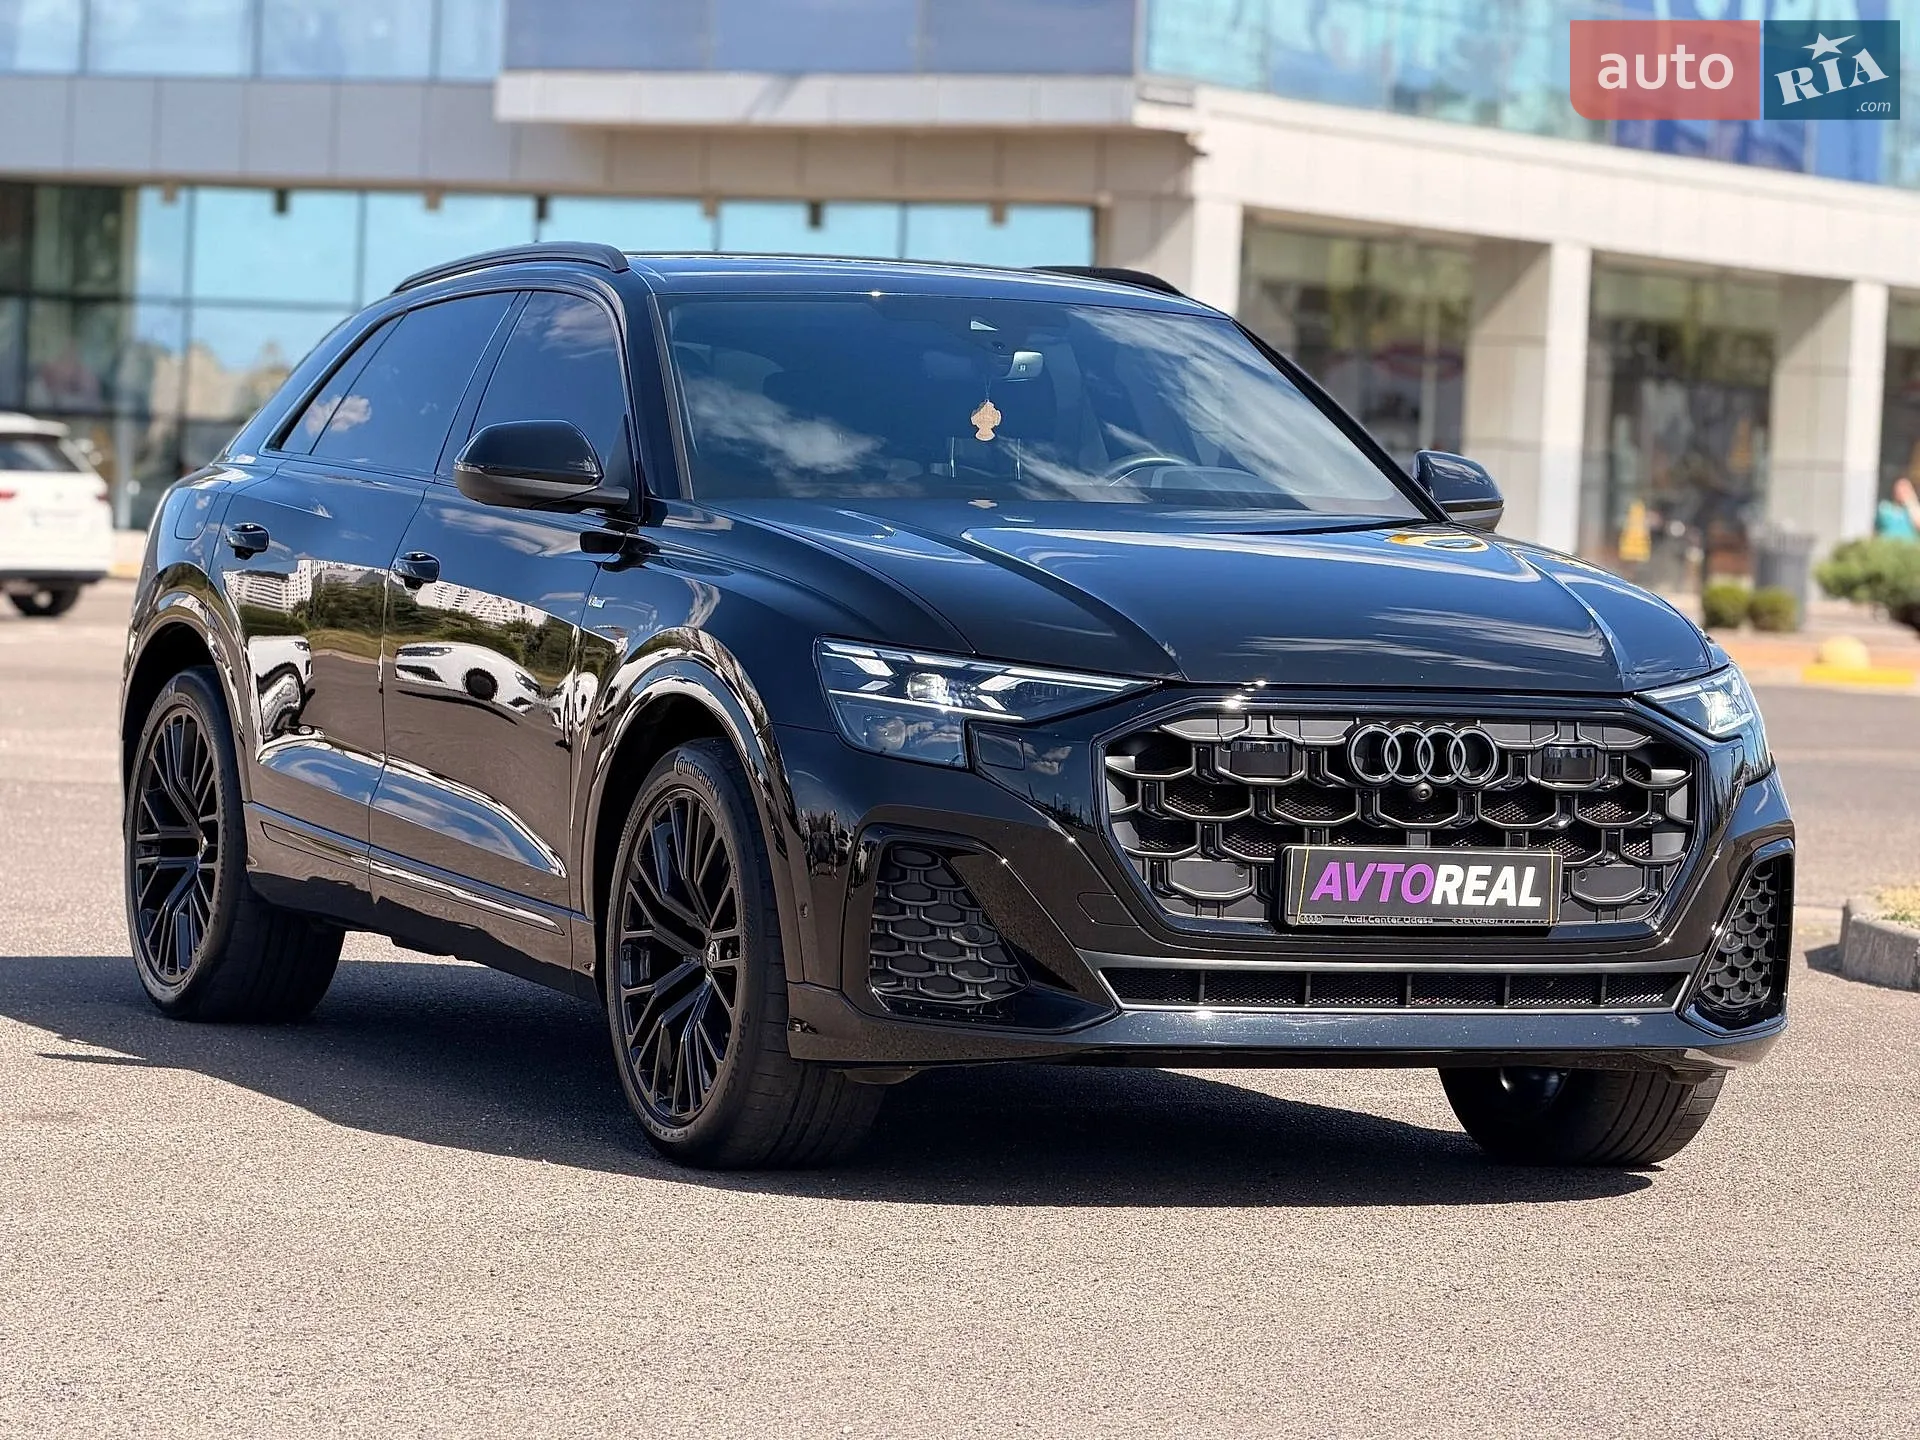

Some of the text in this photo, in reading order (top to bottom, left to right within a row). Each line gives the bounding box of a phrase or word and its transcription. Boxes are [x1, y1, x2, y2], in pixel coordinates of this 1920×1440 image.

[676, 755, 717, 797] Continental
[1310, 861, 1542, 907] AVTOREAL
[1342, 915, 1366, 924] Audi
